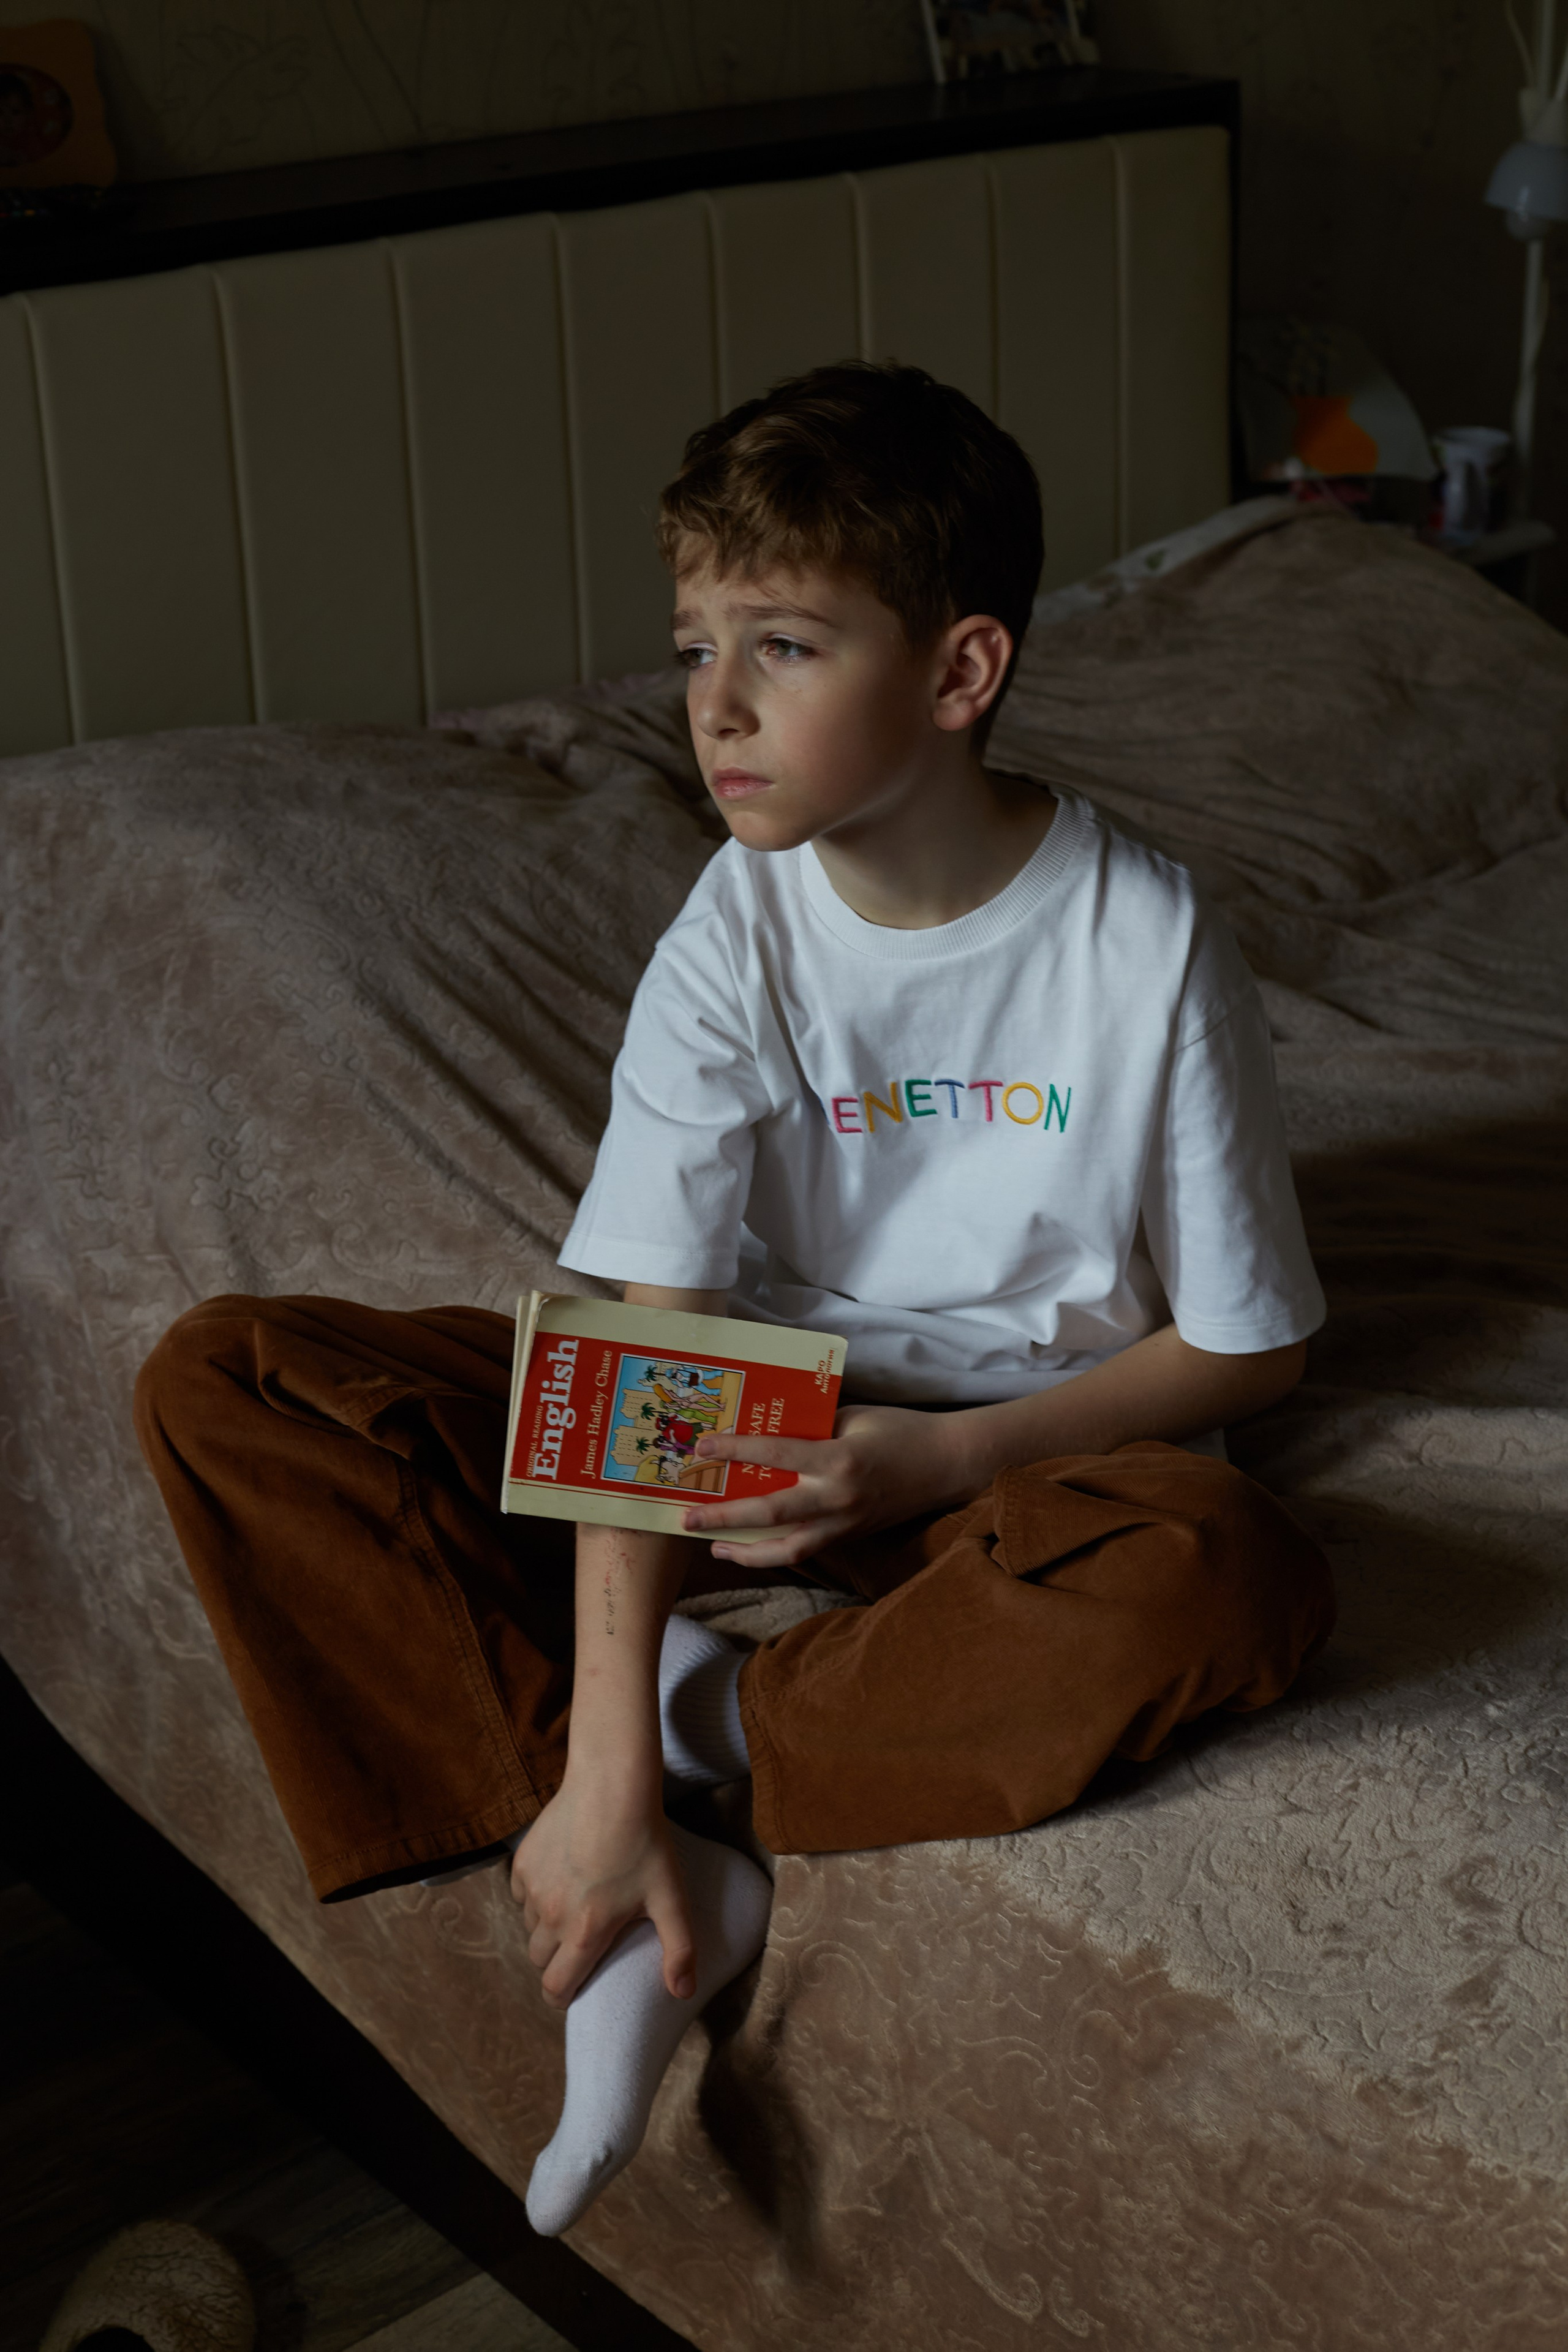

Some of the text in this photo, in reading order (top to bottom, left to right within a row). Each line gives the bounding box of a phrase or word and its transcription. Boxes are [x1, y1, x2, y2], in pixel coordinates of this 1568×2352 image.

[818, 1079, 1072, 1133] ENETTON
[814, 1360, 826, 1385] КАРО
[820, 1349, 835, 1394] Антология
[532, 1339, 579, 1480] English
[581, 1350, 612, 1479] James Hadley Chase
[748, 1403, 766, 1436] SAFE
[767, 1398, 785, 1434] FREE
[526, 1405, 544, 1477] ORIGINAL READING
